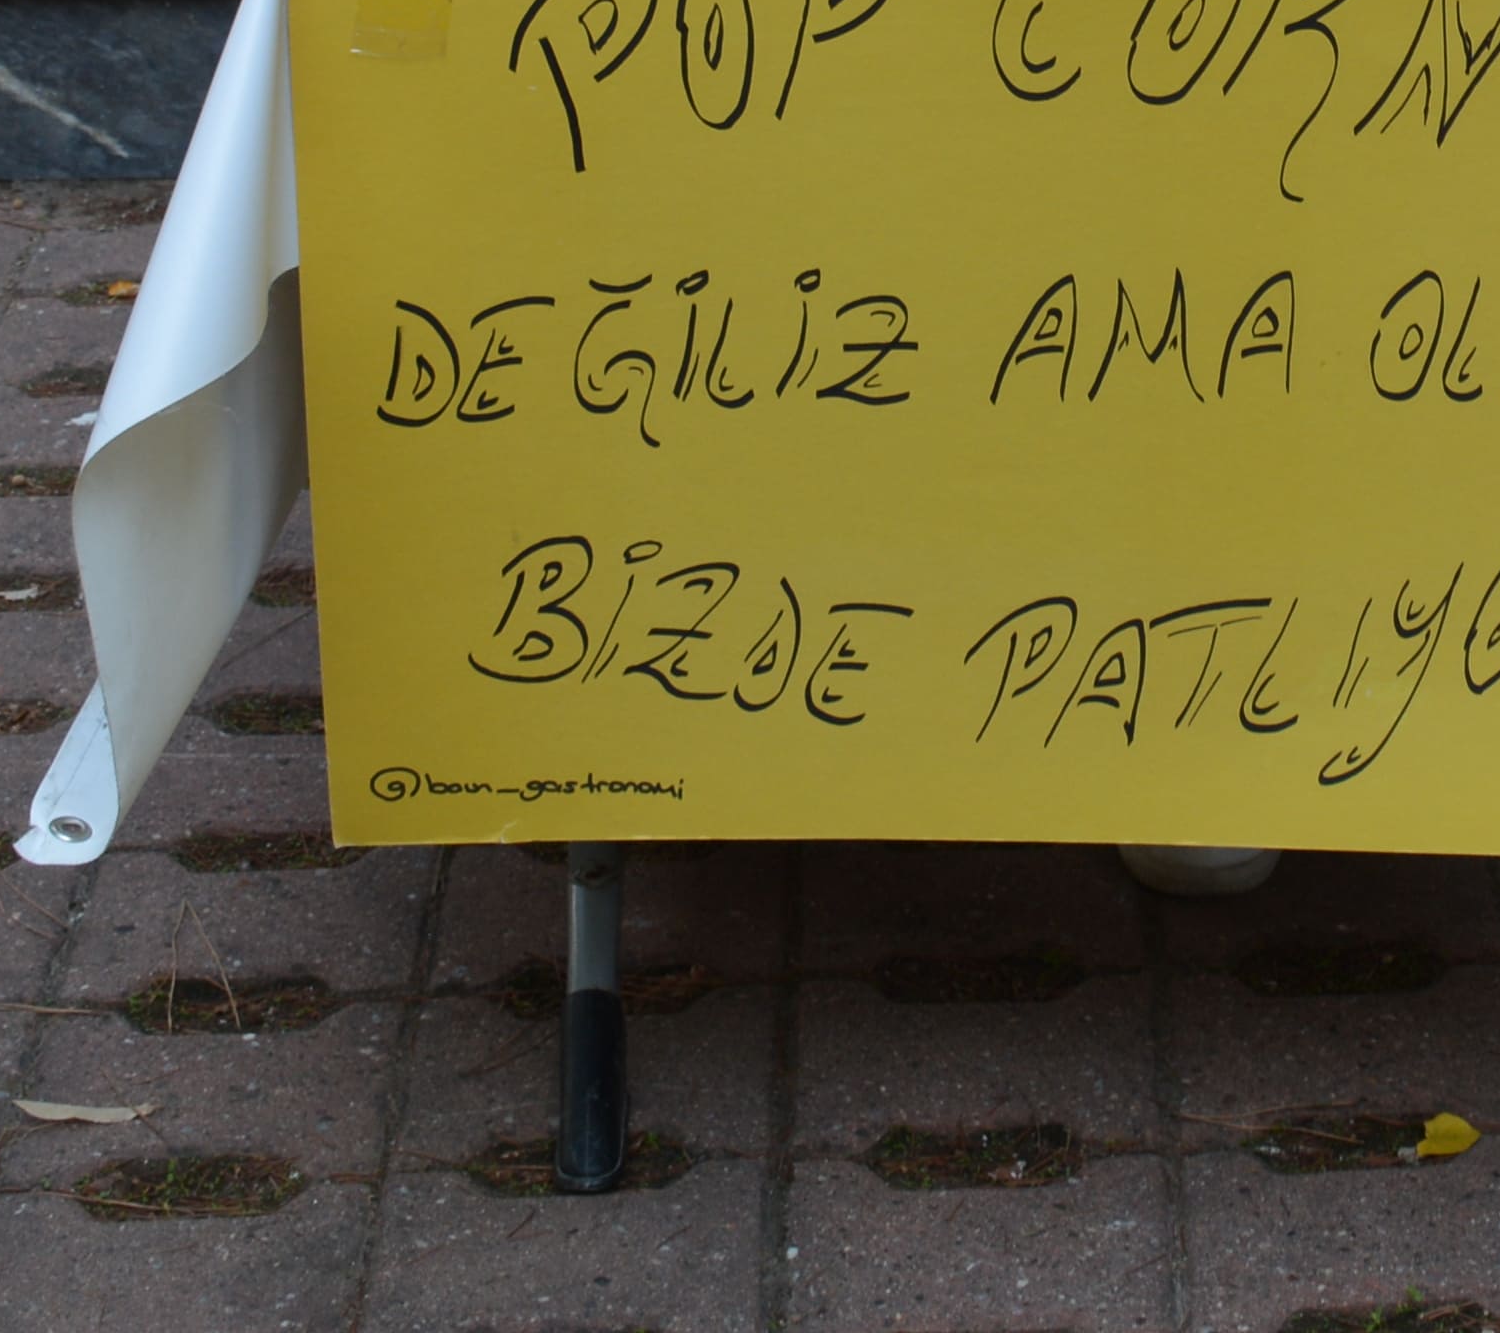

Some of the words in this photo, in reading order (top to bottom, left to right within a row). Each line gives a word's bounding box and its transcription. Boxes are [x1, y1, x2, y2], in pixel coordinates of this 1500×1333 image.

[376, 267, 919, 448] DEĞİLİZ
[989, 266, 1297, 405] AMA
[467, 535, 915, 726] BİZDE
